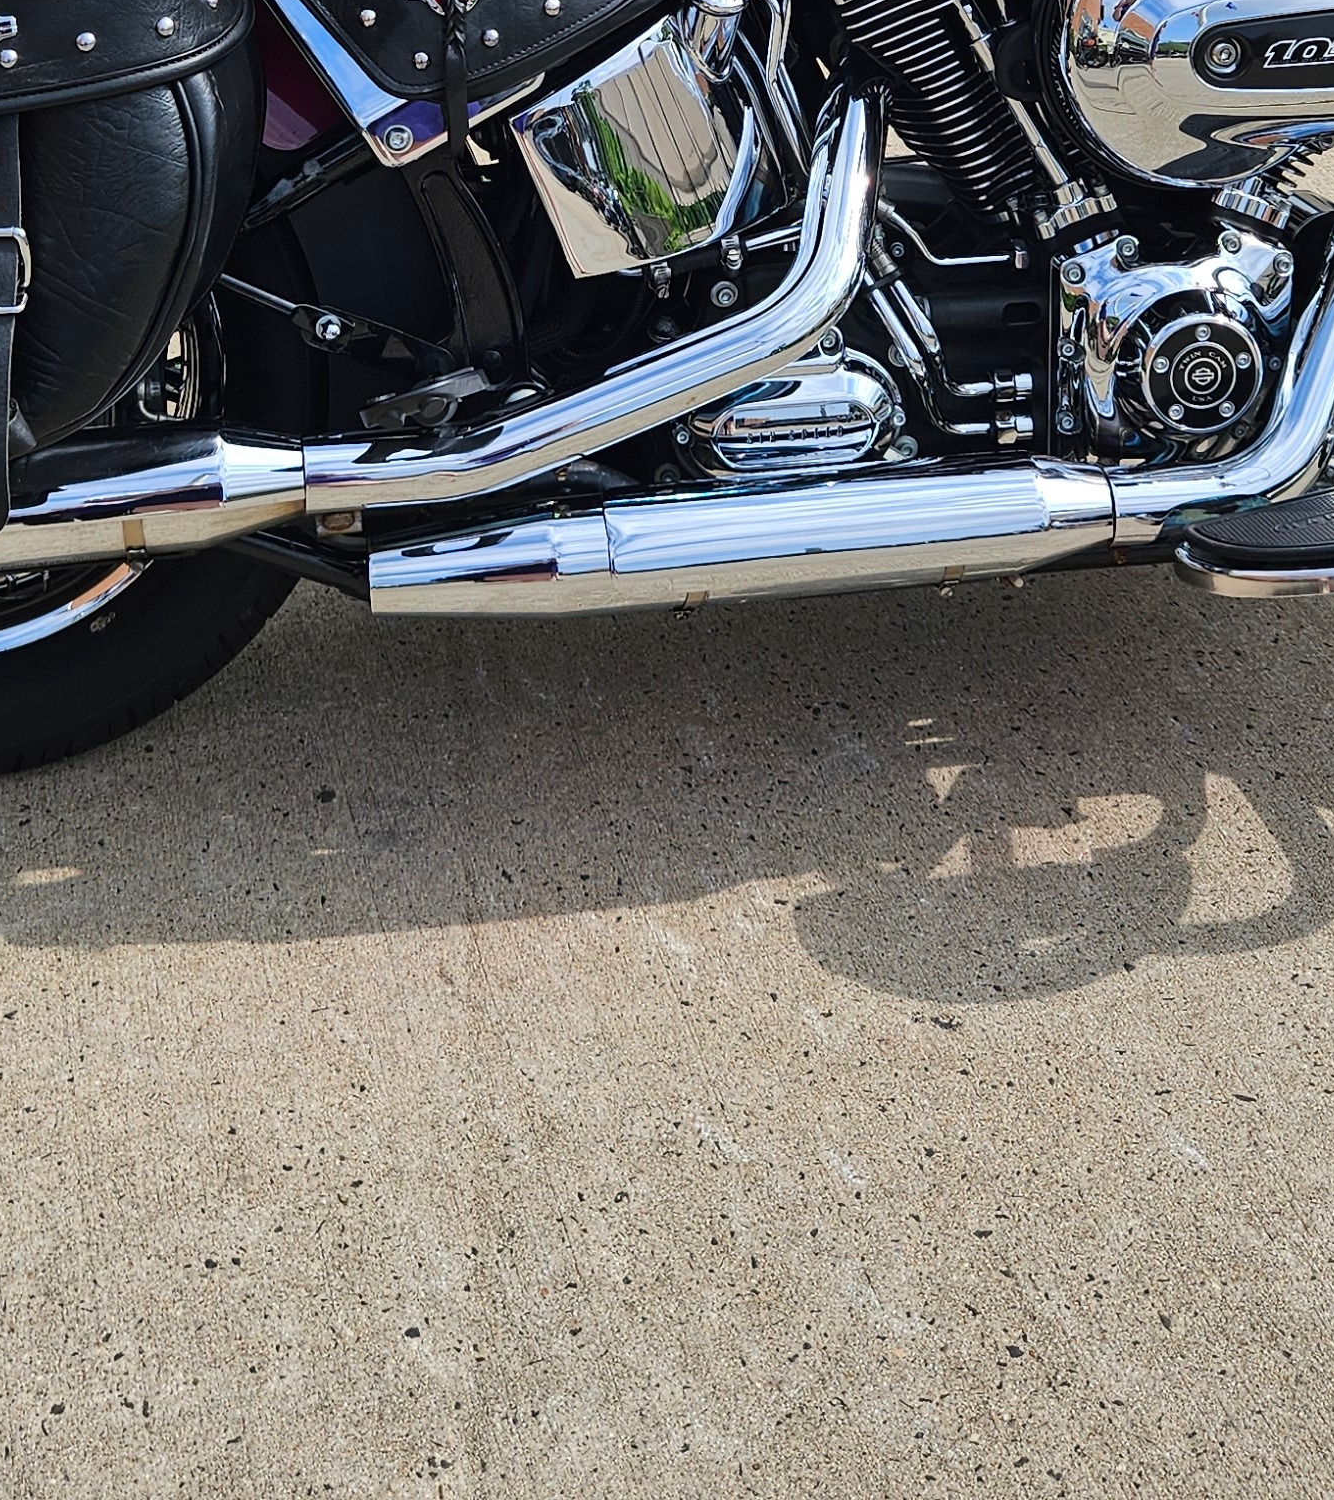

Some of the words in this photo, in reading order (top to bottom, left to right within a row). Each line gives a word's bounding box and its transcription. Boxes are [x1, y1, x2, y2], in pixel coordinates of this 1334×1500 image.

[1178, 350, 1202, 371] TWIN
[1208, 351, 1228, 369] CAM
[788, 425, 844, 441] SPEED
